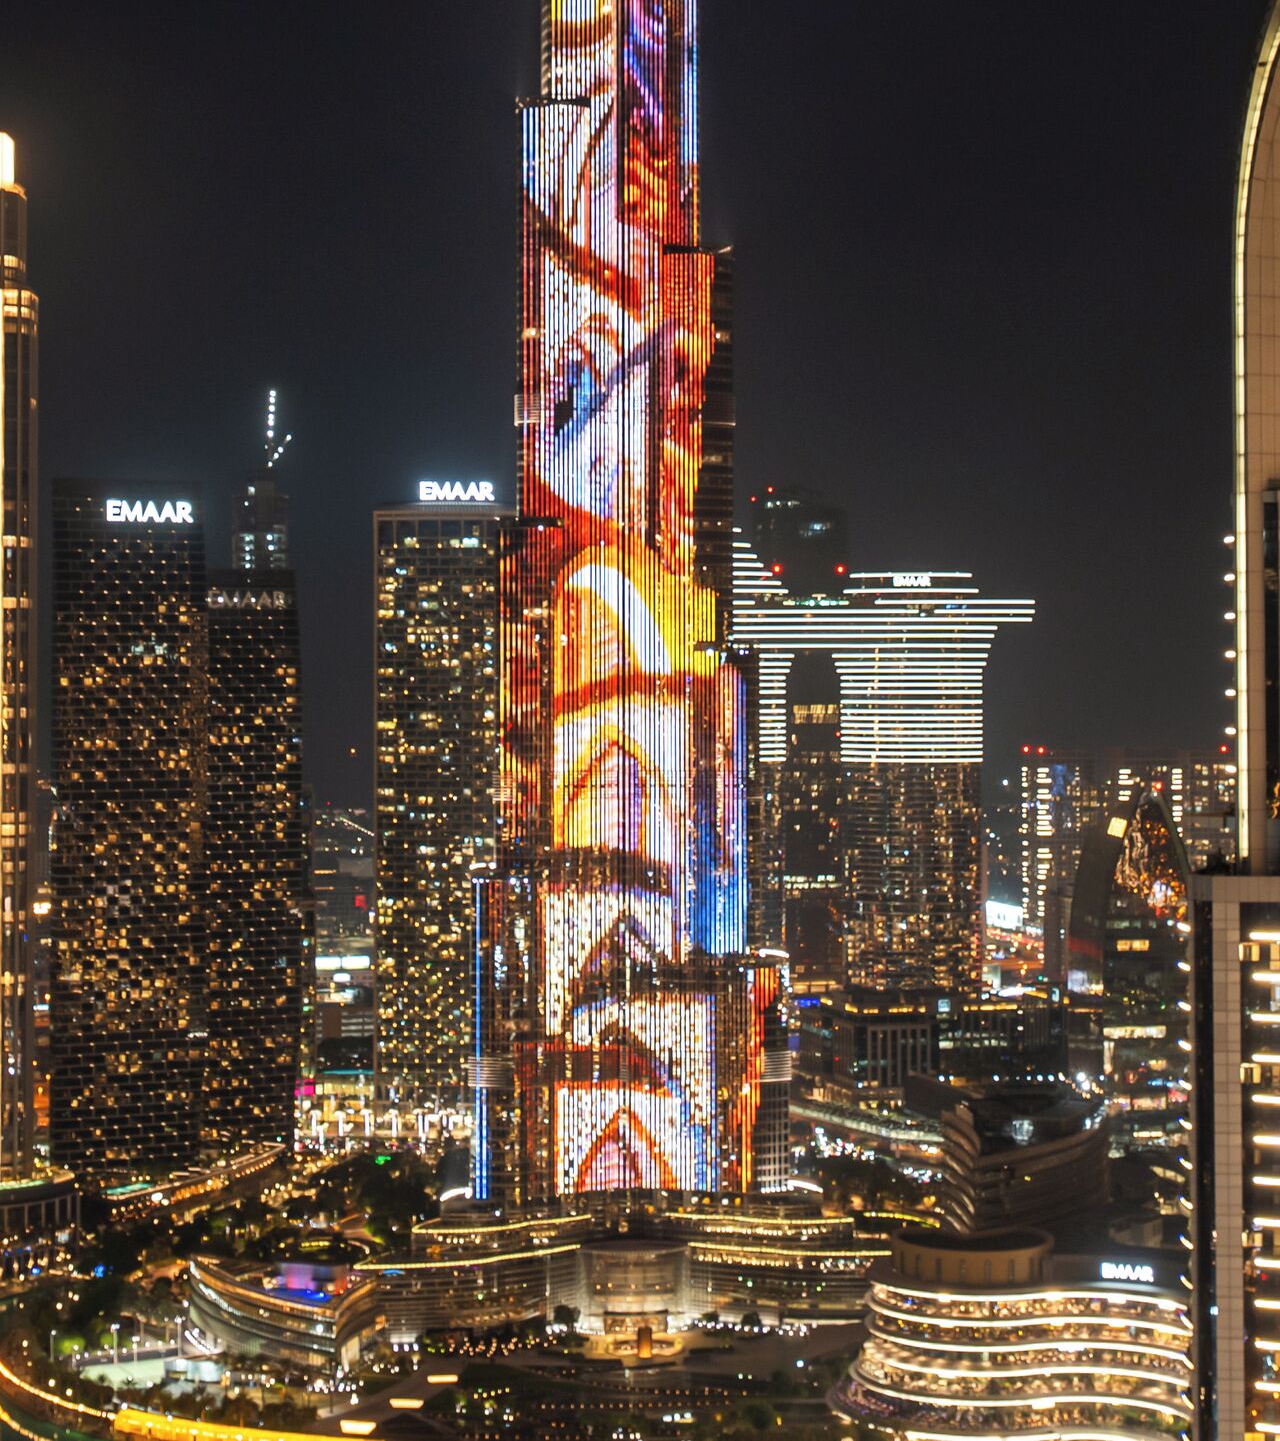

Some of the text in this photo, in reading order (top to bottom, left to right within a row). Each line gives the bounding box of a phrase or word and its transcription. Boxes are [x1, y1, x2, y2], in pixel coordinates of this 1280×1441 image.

[419, 481, 495, 501] EMAAR
[106, 499, 194, 523] EMAAR
[207, 591, 287, 609] EMAAR
